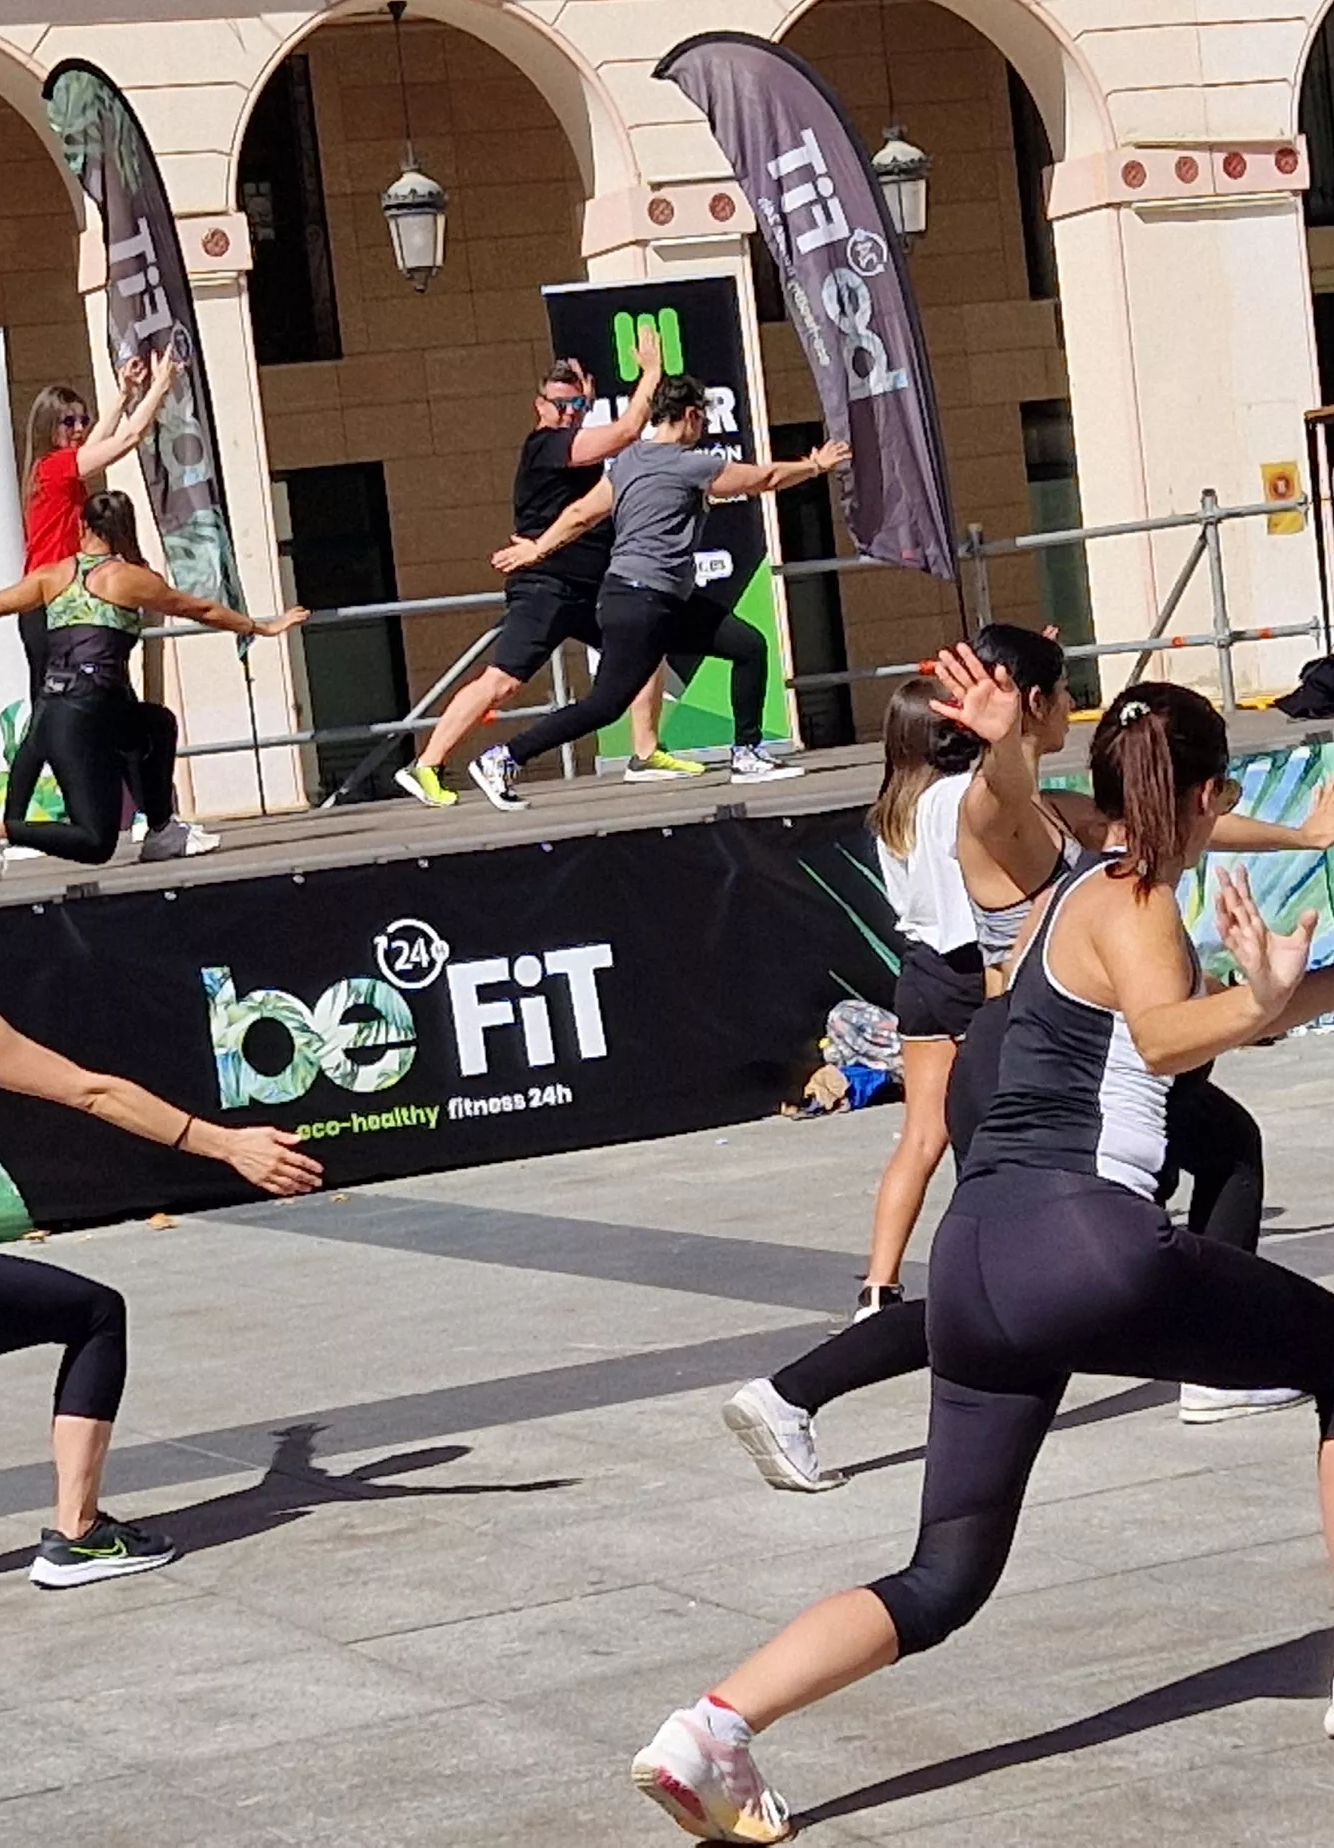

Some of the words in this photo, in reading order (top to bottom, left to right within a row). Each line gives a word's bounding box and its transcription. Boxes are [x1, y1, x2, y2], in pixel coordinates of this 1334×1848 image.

[201, 965, 417, 1110] be
[446, 943, 614, 1078] FiT
[297, 1104, 440, 1141] eco-healthy
[447, 1093, 526, 1120] fitness
[528, 1083, 573, 1108] 24h
